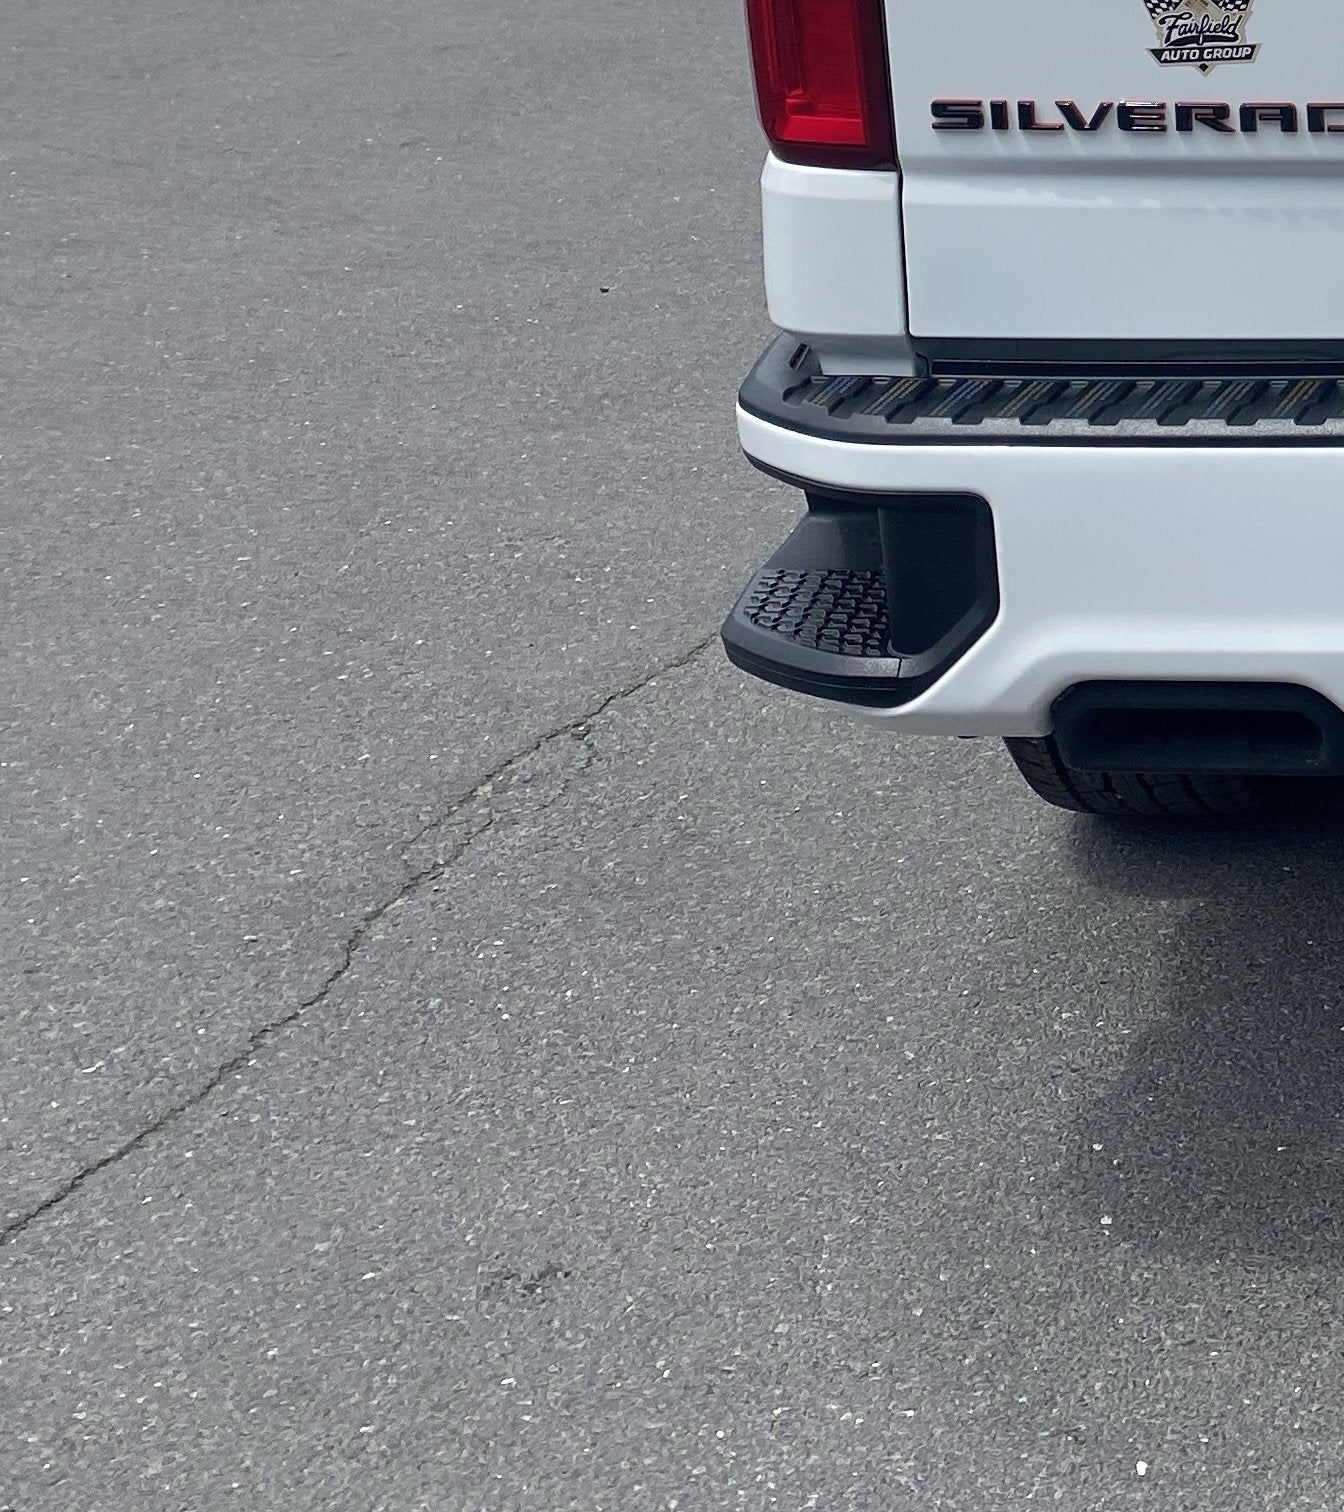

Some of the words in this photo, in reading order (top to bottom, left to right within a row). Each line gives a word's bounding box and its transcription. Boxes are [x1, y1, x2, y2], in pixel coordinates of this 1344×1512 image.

[1158, 11, 1243, 46] Fairfield
[1160, 48, 1200, 62] AUTO
[1203, 46, 1252, 60] GROUP
